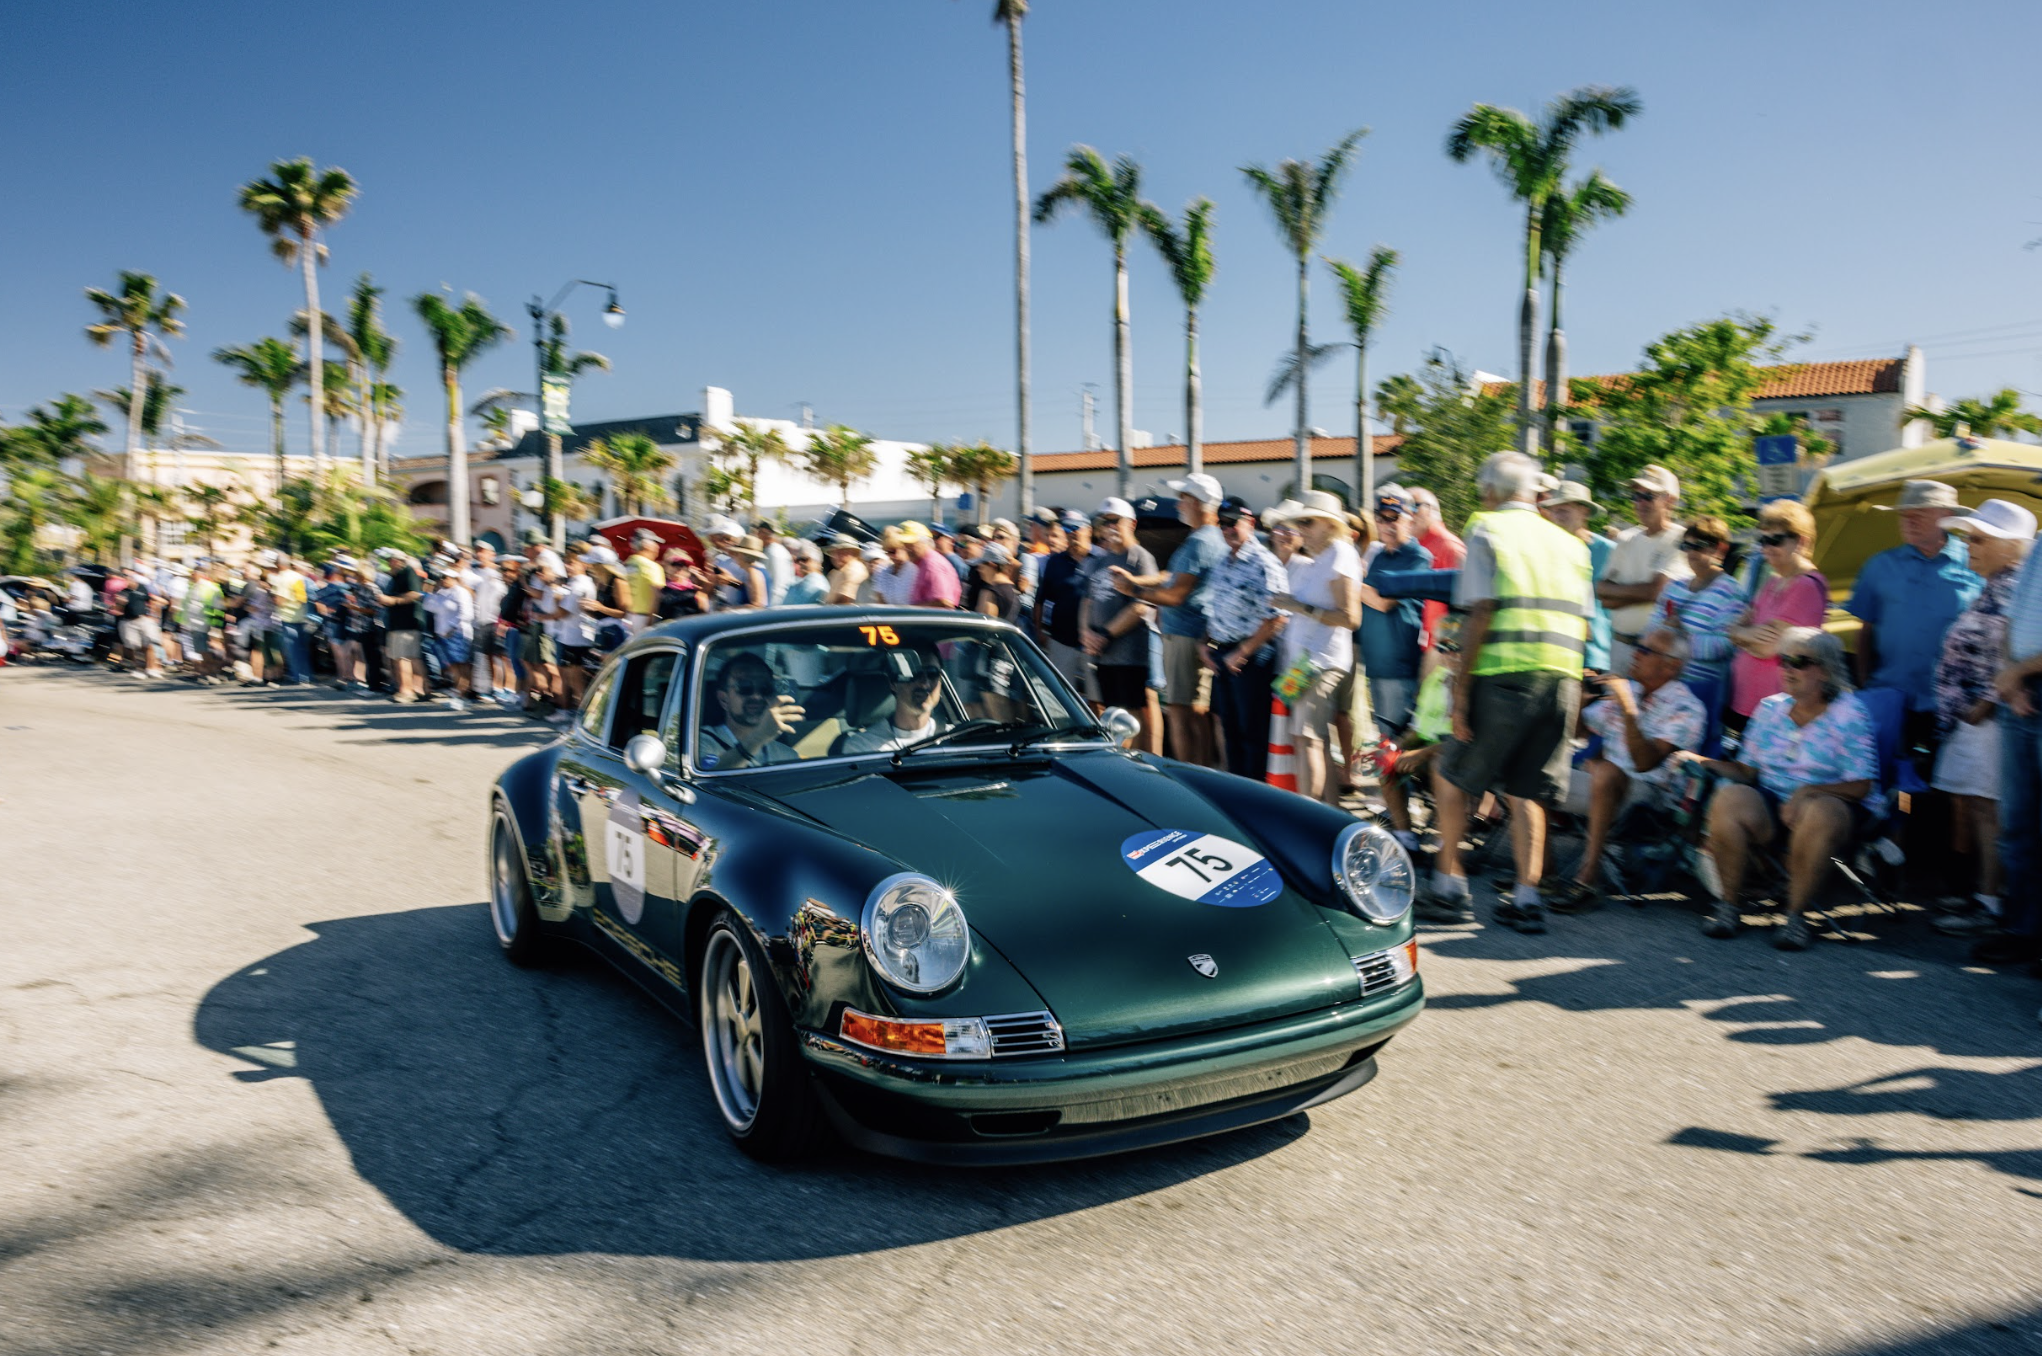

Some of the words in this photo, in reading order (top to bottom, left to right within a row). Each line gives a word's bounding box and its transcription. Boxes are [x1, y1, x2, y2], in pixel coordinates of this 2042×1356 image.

[858, 625, 900, 646] 75
[615, 831, 634, 879] 75
[1165, 847, 1233, 883] 75
